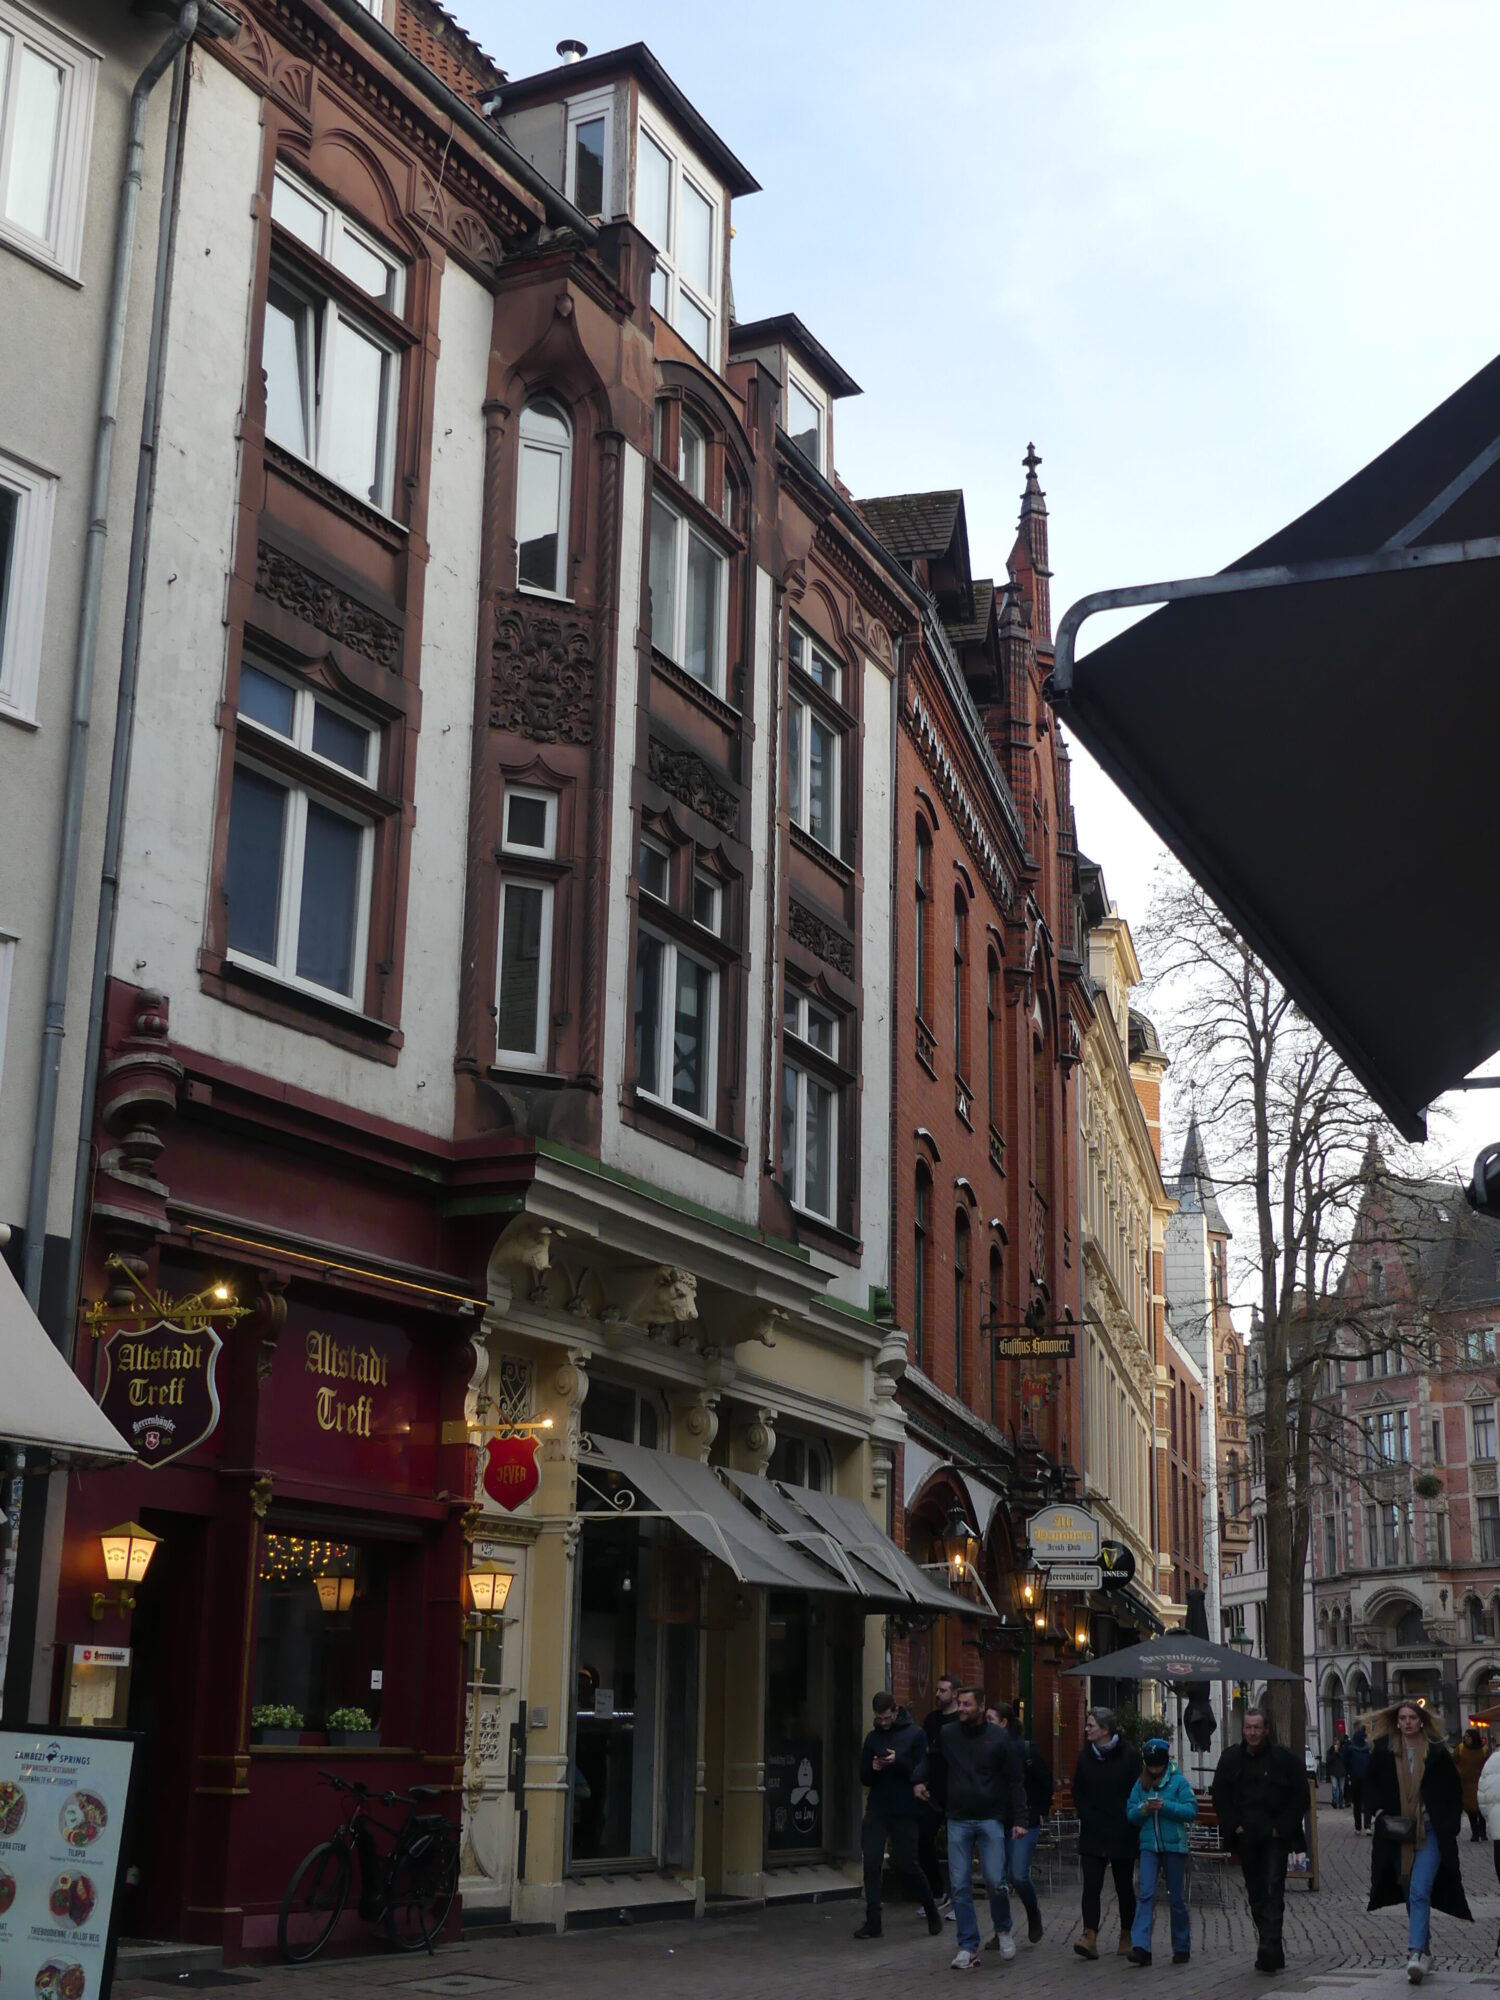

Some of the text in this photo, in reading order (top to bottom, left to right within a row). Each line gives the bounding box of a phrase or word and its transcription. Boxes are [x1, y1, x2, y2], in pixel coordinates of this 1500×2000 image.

[117, 1342, 203, 1372] Altstadt
[304, 1330, 389, 1388] Altstadt
[128, 1377, 186, 1407] Treff
[316, 1386, 373, 1438] Treff
[497, 1464, 527, 1484] JEVER
[1067, 1544, 1081, 1552] Pub
[59, 1754, 91, 1765] SPRINGS
